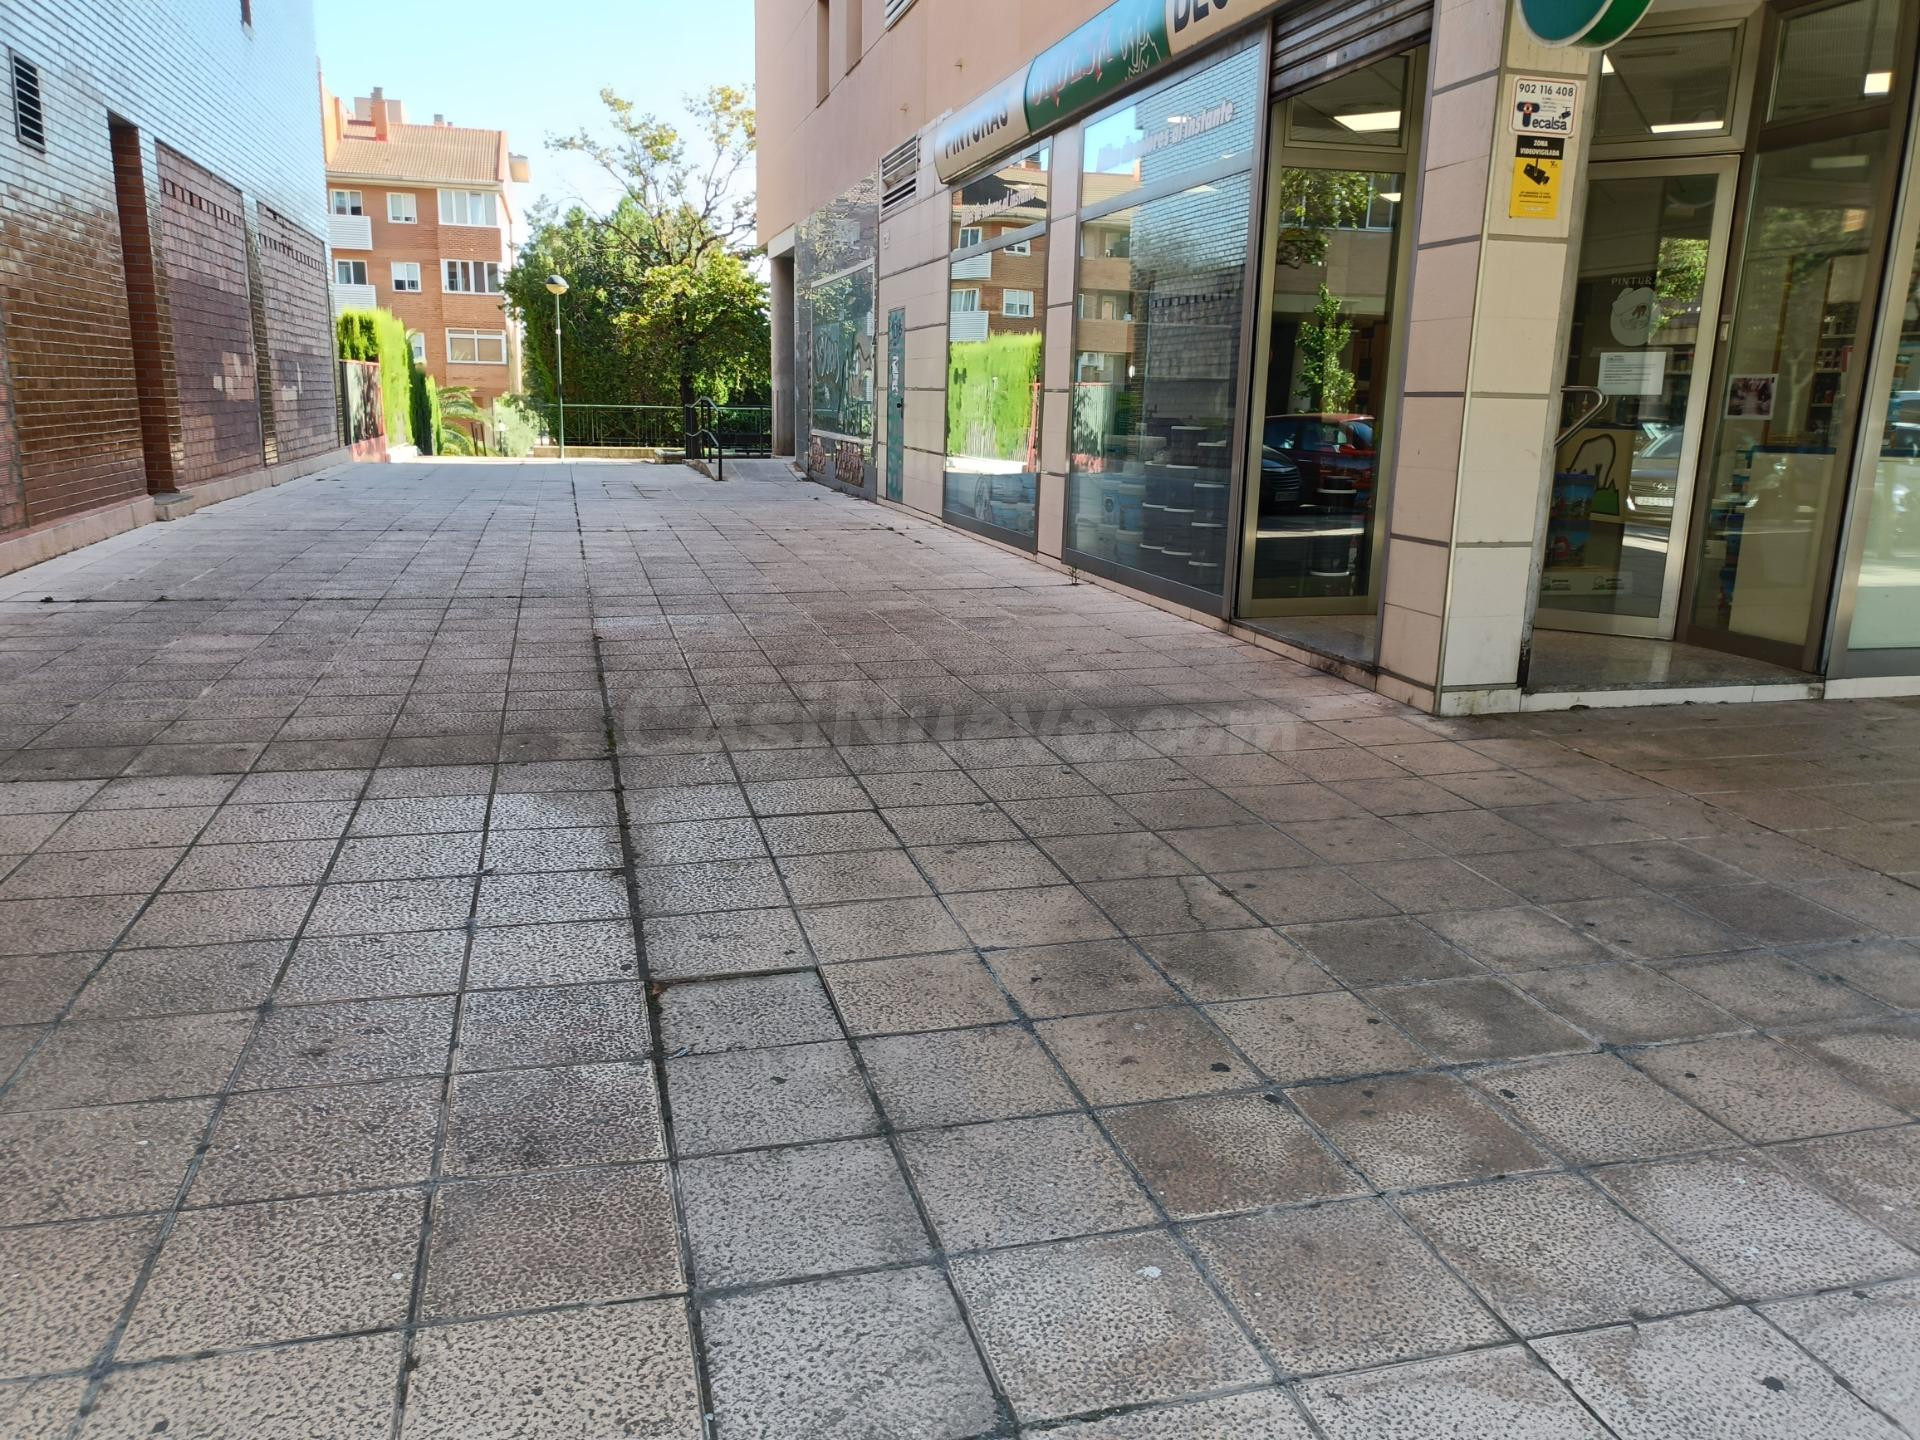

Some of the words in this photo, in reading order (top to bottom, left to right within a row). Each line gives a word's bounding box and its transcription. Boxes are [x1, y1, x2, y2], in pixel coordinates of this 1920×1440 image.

[1519, 83, 1537, 94] 902
[1540, 85, 1553, 95] 116
[1555, 86, 1574, 97] 408
[1517, 101, 1568, 131] Tecalsa
[1533, 139, 1548, 147] ZONA
[1520, 147, 1560, 156] VIDEOVIGILADA
